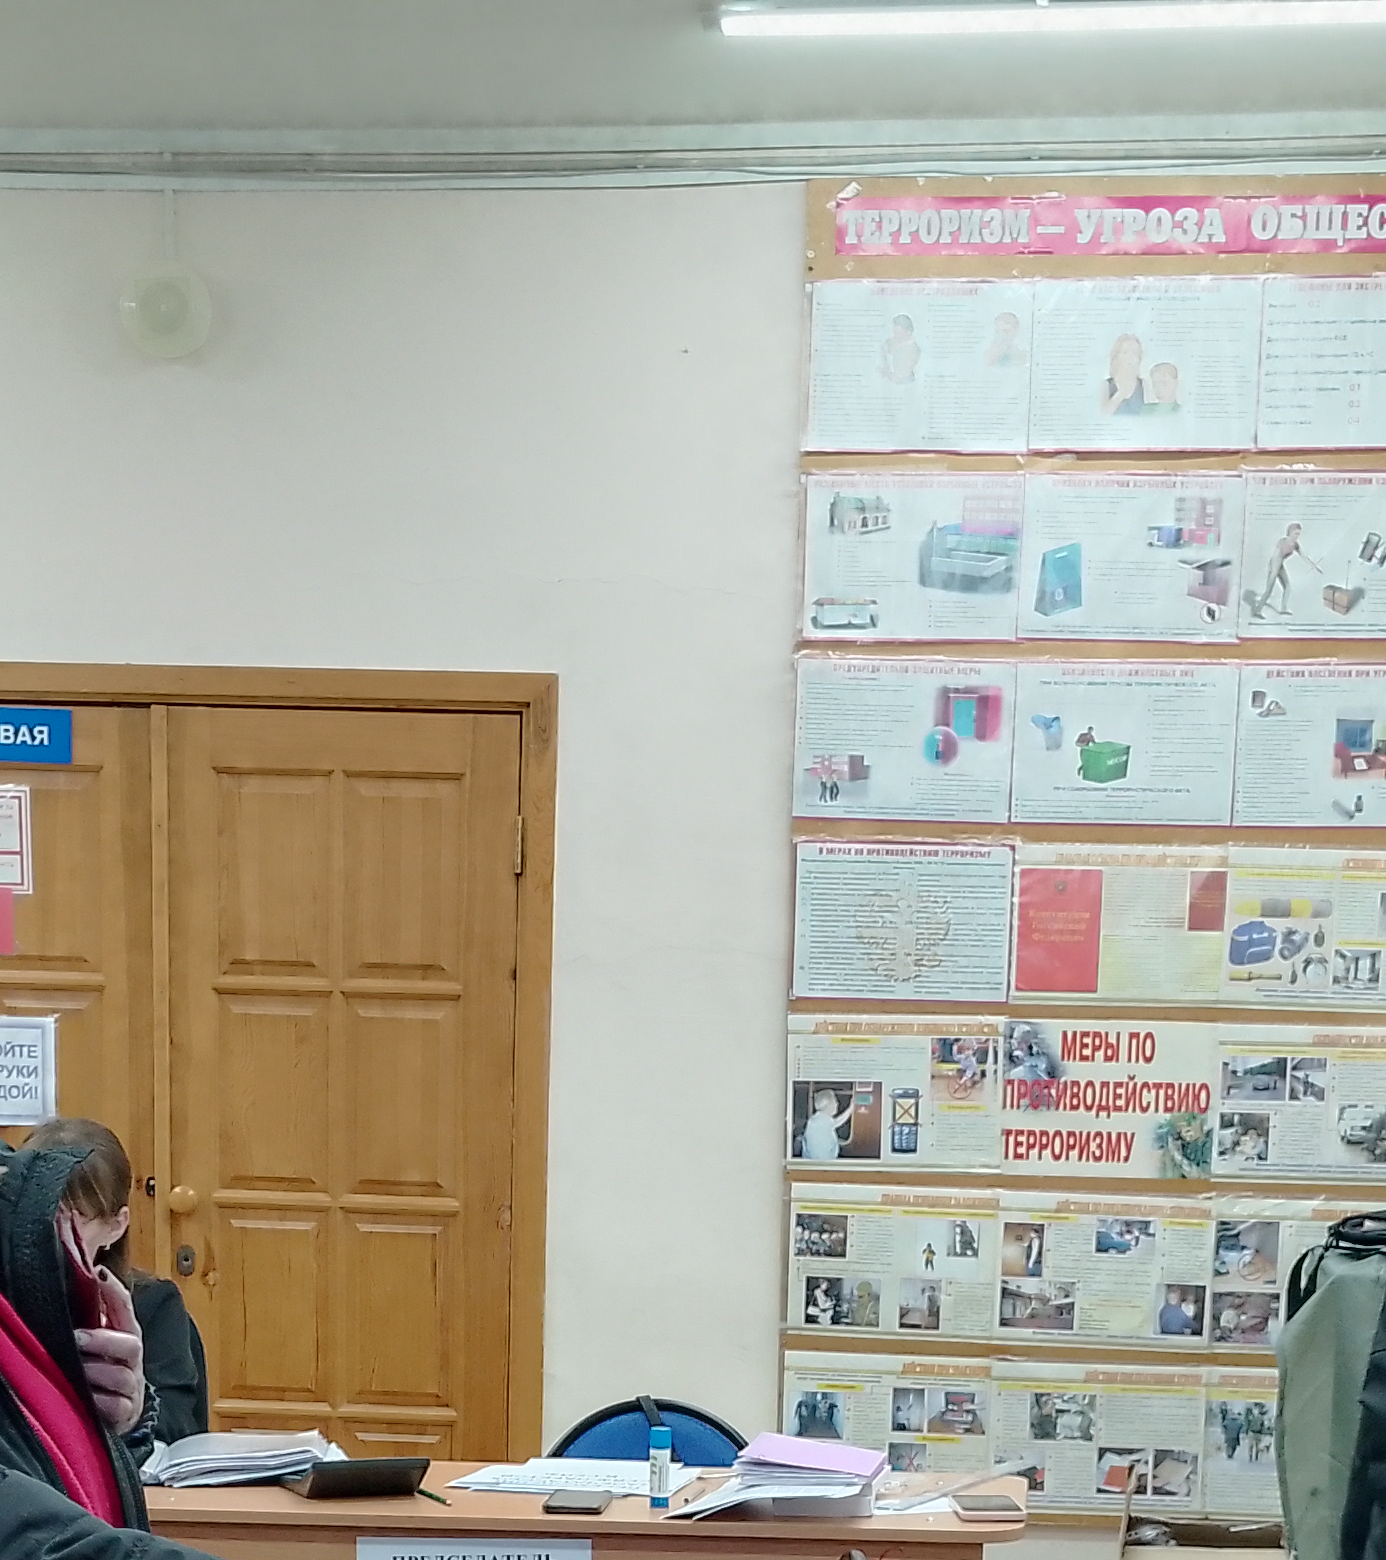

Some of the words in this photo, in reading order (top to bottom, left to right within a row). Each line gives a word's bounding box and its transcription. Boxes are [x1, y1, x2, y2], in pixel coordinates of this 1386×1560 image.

[842, 207, 1031, 245] ТЕРРОРИЗМ
[1074, 206, 1227, 244] УГРОЗА
[1060, 1030, 1121, 1064] МЕРЫ
[1127, 1031, 1156, 1064] ПО
[1002, 1074, 1211, 1120] ПРОТИВОДЕЙСТВИЮ
[1002, 1128, 1136, 1164] ТЕРРОРИЗМУ
